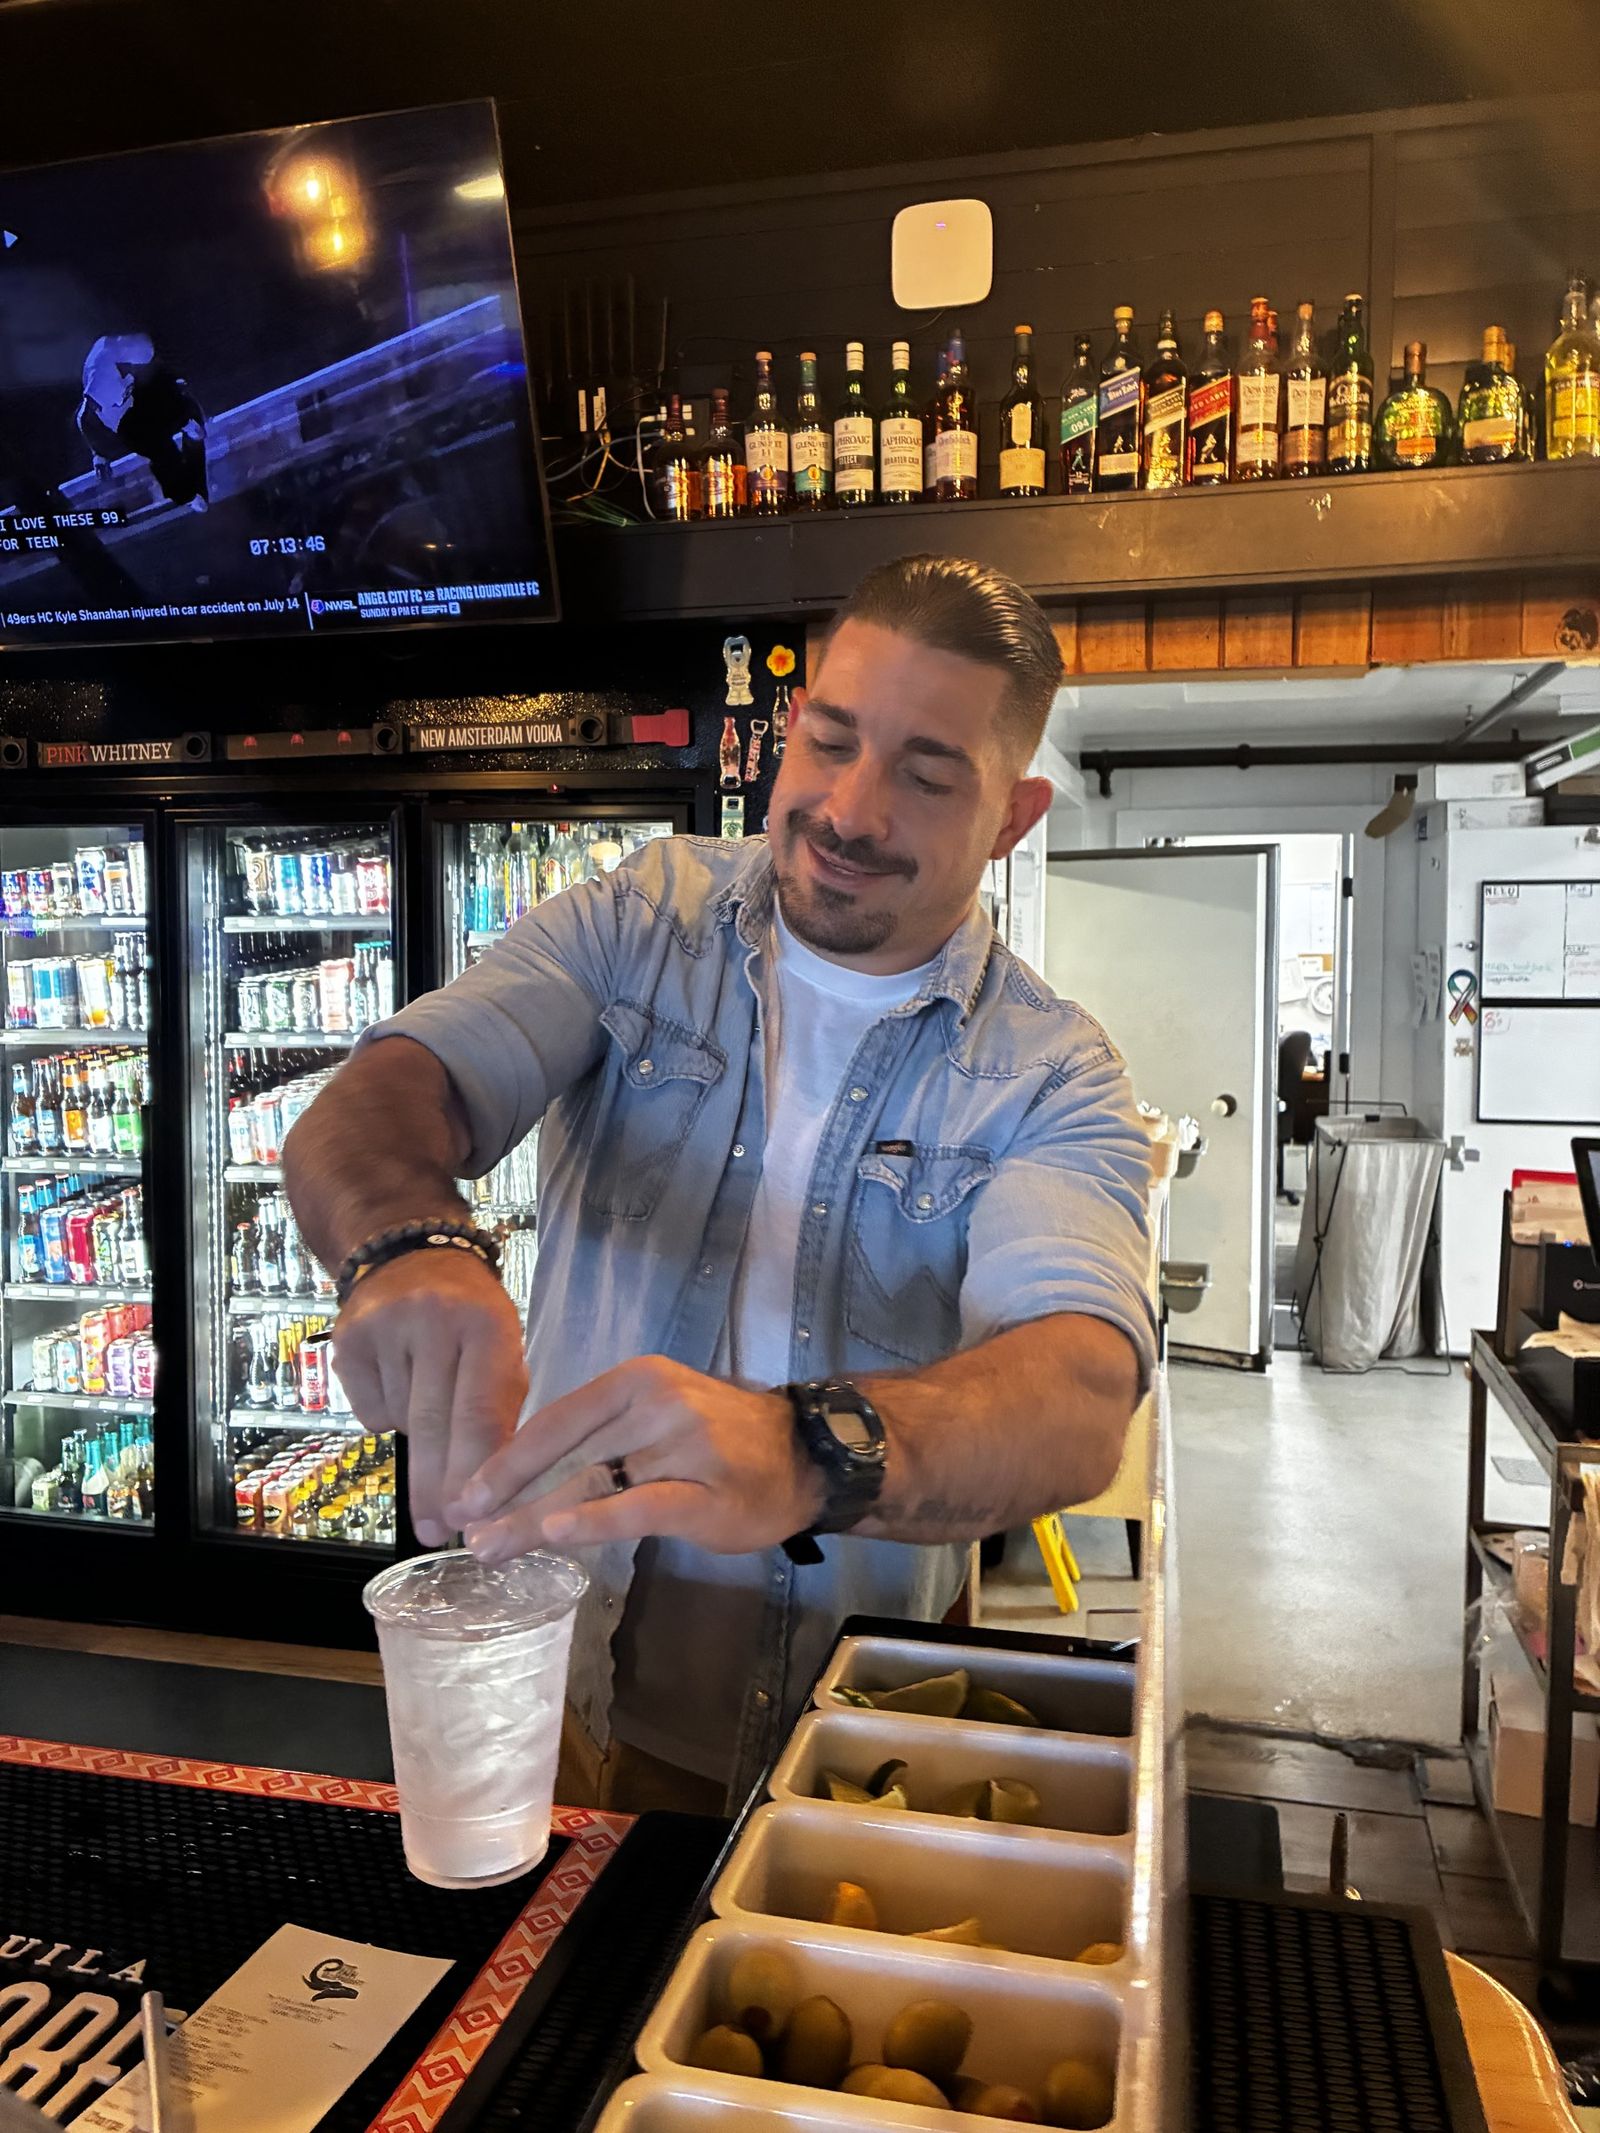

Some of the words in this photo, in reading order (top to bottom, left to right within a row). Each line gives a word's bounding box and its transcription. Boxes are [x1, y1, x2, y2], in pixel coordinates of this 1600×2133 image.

[0, 519, 6, 531] I
[14, 516, 46, 530] LOVE
[53, 513, 95, 527] THESE
[101, 511, 125, 524] 99.
[26, 536, 65, 549] TEEN.
[249, 536, 326, 556] 07:13:46
[358, 591, 388, 606] ANGEL
[388, 590, 409, 604] CITY
[409, 588, 423, 603] FC
[436, 585, 474, 601] RACING
[473, 582, 526, 599] LOUISVILLE
[526, 581, 540, 596] FC
[7, 613, 36, 625] 49ers
[37, 612, 53, 624] HC
[55, 610, 77, 625] Kyle
[79, 607, 130, 621] Shanahan
[131, 605, 167, 620] injured
[169, 605, 180, 617] in
[181, 606, 198, 616] car
[200, 601, 246, 615] accident
[248, 601, 261, 612] on
[263, 599, 284, 613] July
[286, 597, 300, 609] 14
[325, 600, 357, 611] NWSL
[360, 607, 390, 618] SUNDAY
[391, 606, 397, 616] 9
[398, 605, 410, 616] PM
[411, 605, 420, 615] ET
[420, 728, 446, 748] NEW
[448, 725, 523, 747] AMSTERDAM
[526, 723, 562, 744] VODKA
[47, 744, 88, 764] PINK
[90, 741, 173, 763] WHITNEY
